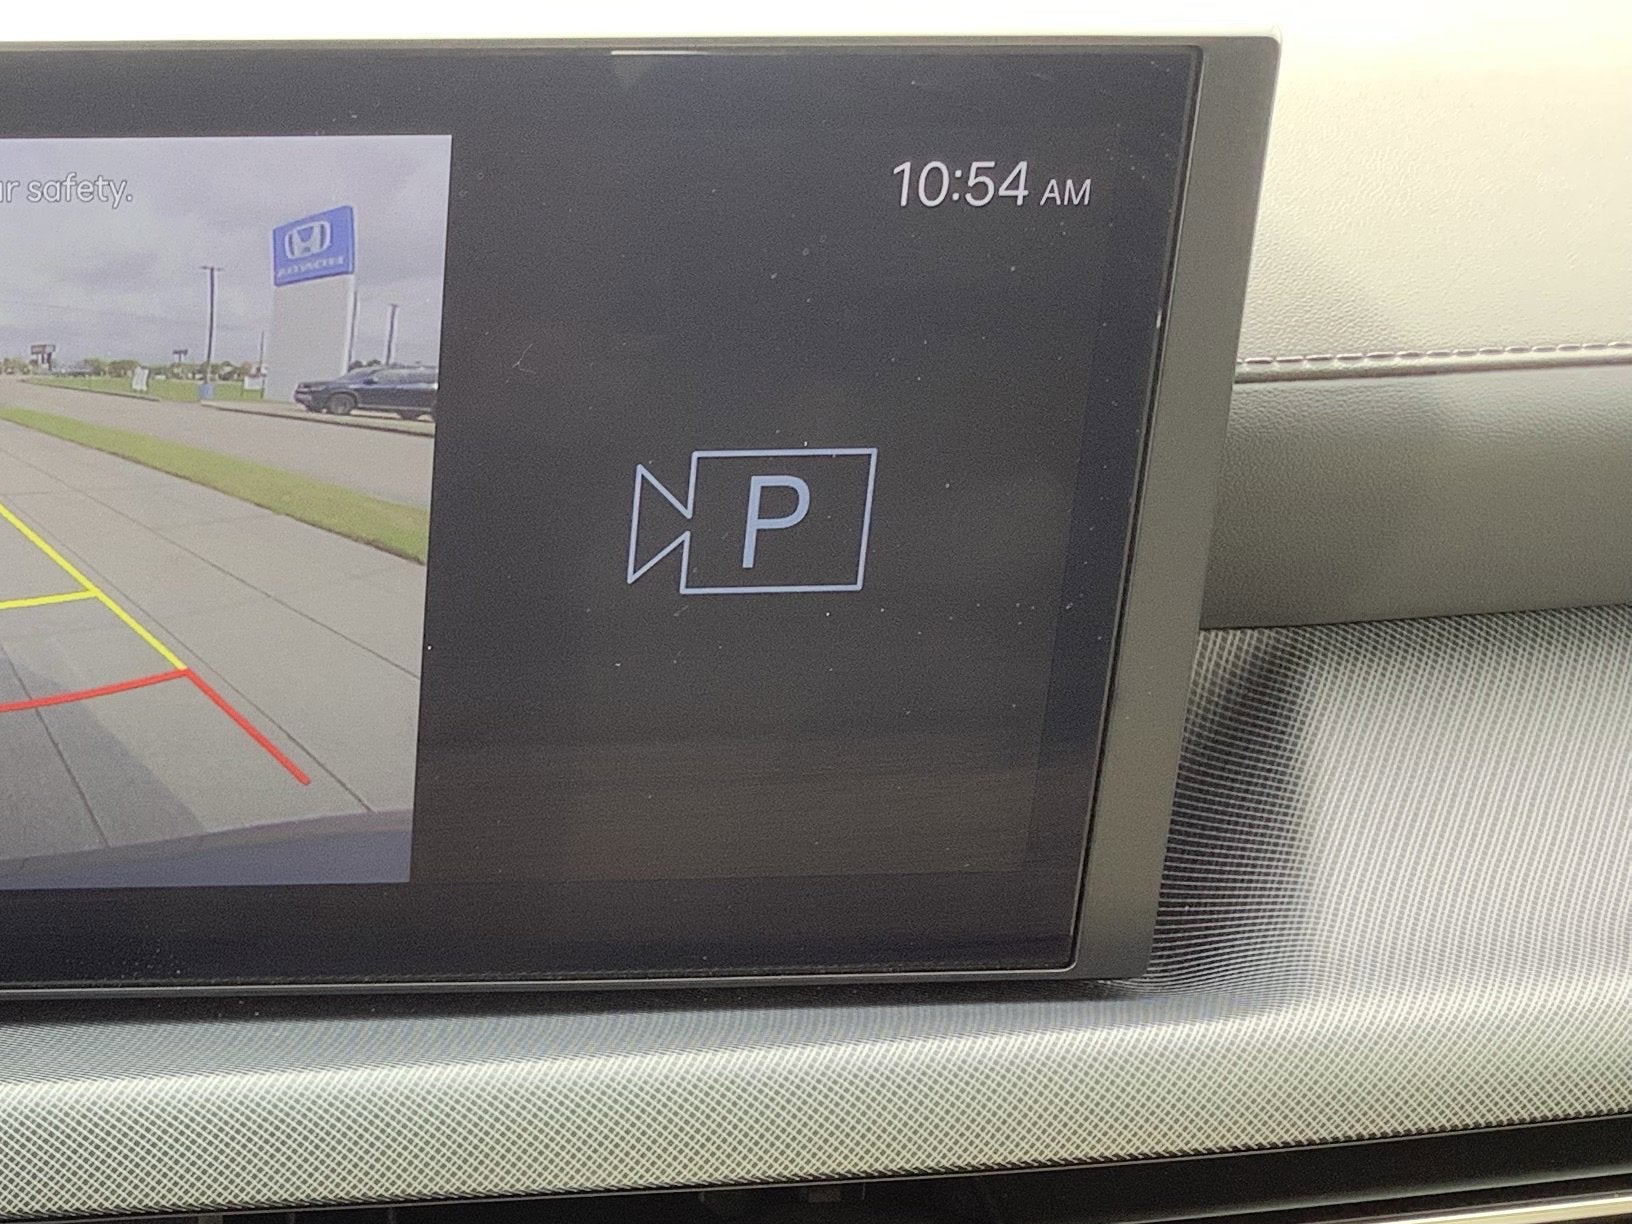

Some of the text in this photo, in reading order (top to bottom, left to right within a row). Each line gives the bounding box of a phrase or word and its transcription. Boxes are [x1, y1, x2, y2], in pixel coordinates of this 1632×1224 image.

[25, 172, 133, 209] safety.
[893, 160, 1092, 207] 10:54 AM
[742, 474, 811, 569] P
